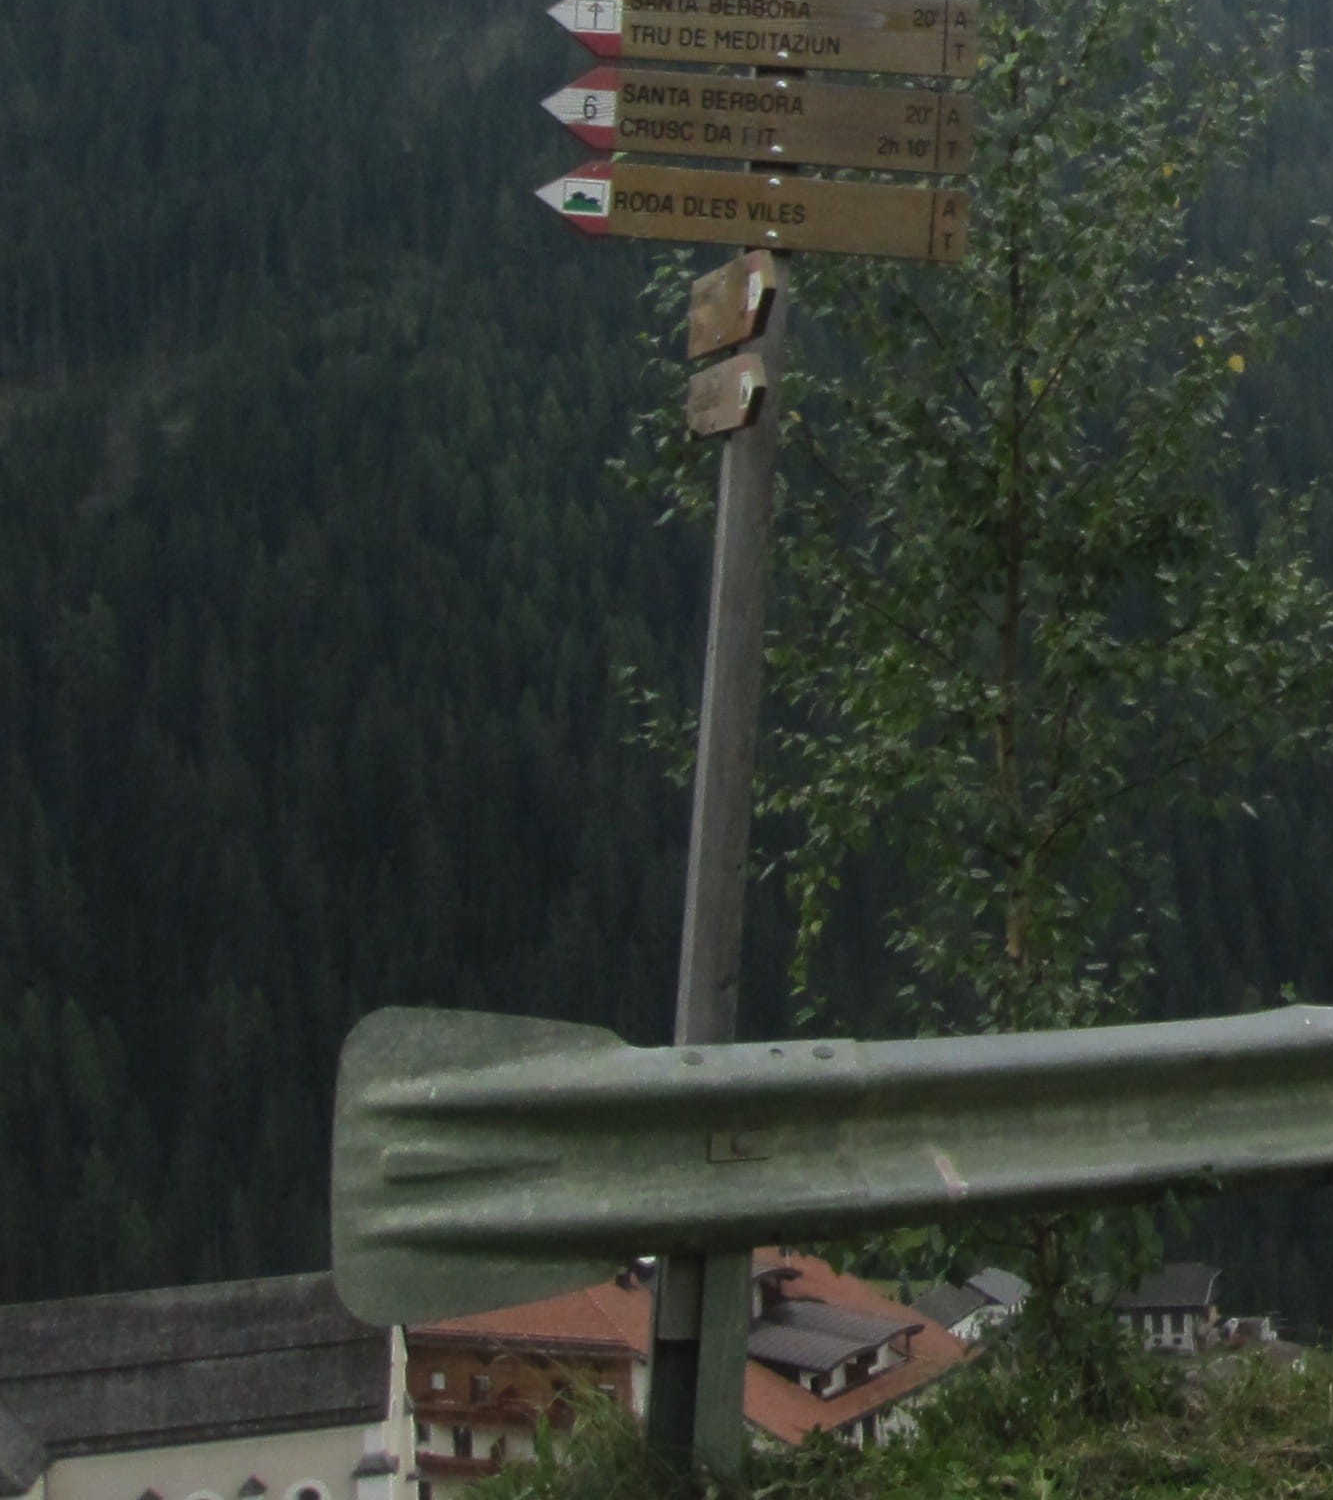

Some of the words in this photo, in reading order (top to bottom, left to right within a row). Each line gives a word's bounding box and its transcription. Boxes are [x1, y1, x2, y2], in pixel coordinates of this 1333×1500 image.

[955, 11, 966, 28] A
[631, 25, 671, 46] TRU
[679, 27, 707, 47] DE
[714, 31, 840, 55] MEDITAZIUN
[953, 44, 965, 60] T
[583, 96, 597, 119] 6
[622, 84, 690, 107] SANTA
[702, 89, 804, 115] BERBORA
[947, 109, 960, 126] A
[620, 118, 693, 141] CRUSC
[704, 124, 731, 142] DA
[948, 141, 959, 158] T
[614, 191, 674, 215] RODA
[683, 196, 737, 219] DLES
[747, 203, 805, 224] VILES
[943, 200, 955, 217] A
[943, 234, 953, 251] T
